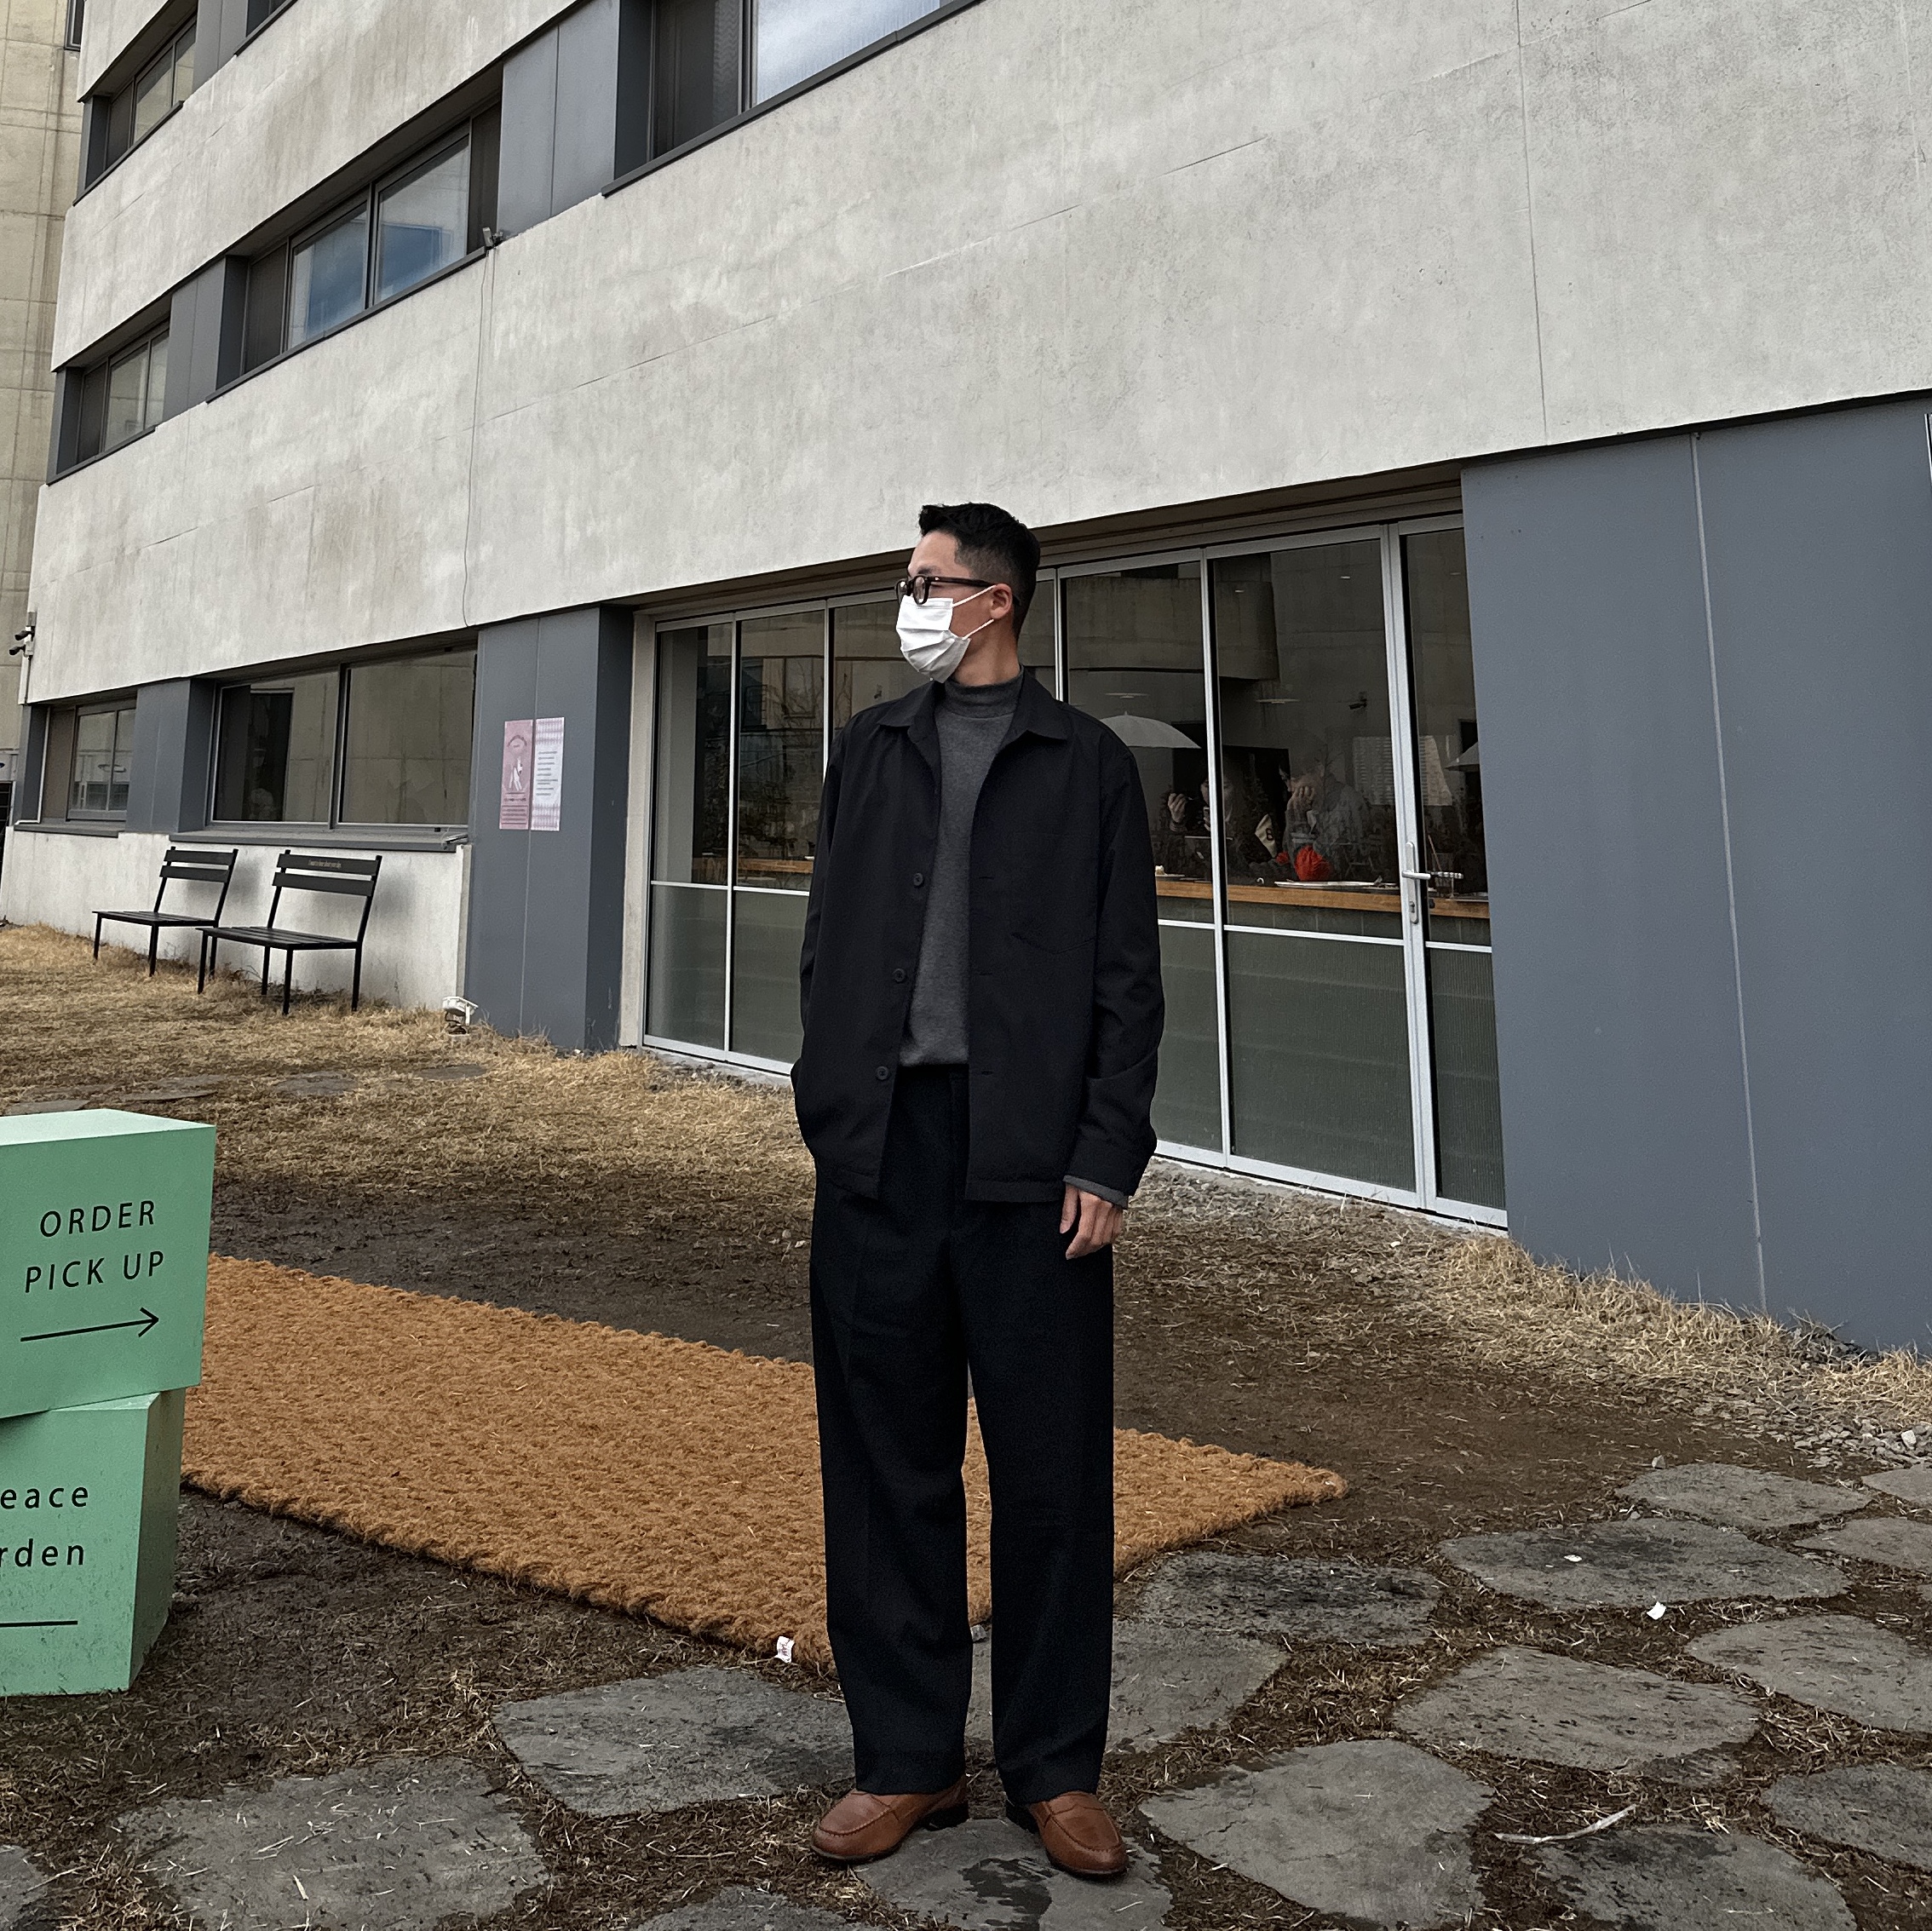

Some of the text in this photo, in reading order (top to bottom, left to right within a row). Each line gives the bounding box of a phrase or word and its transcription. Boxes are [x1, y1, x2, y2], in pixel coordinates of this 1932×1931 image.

[40, 1200, 155, 1238] ORDER
[25, 1250, 164, 1294] PICK UP
